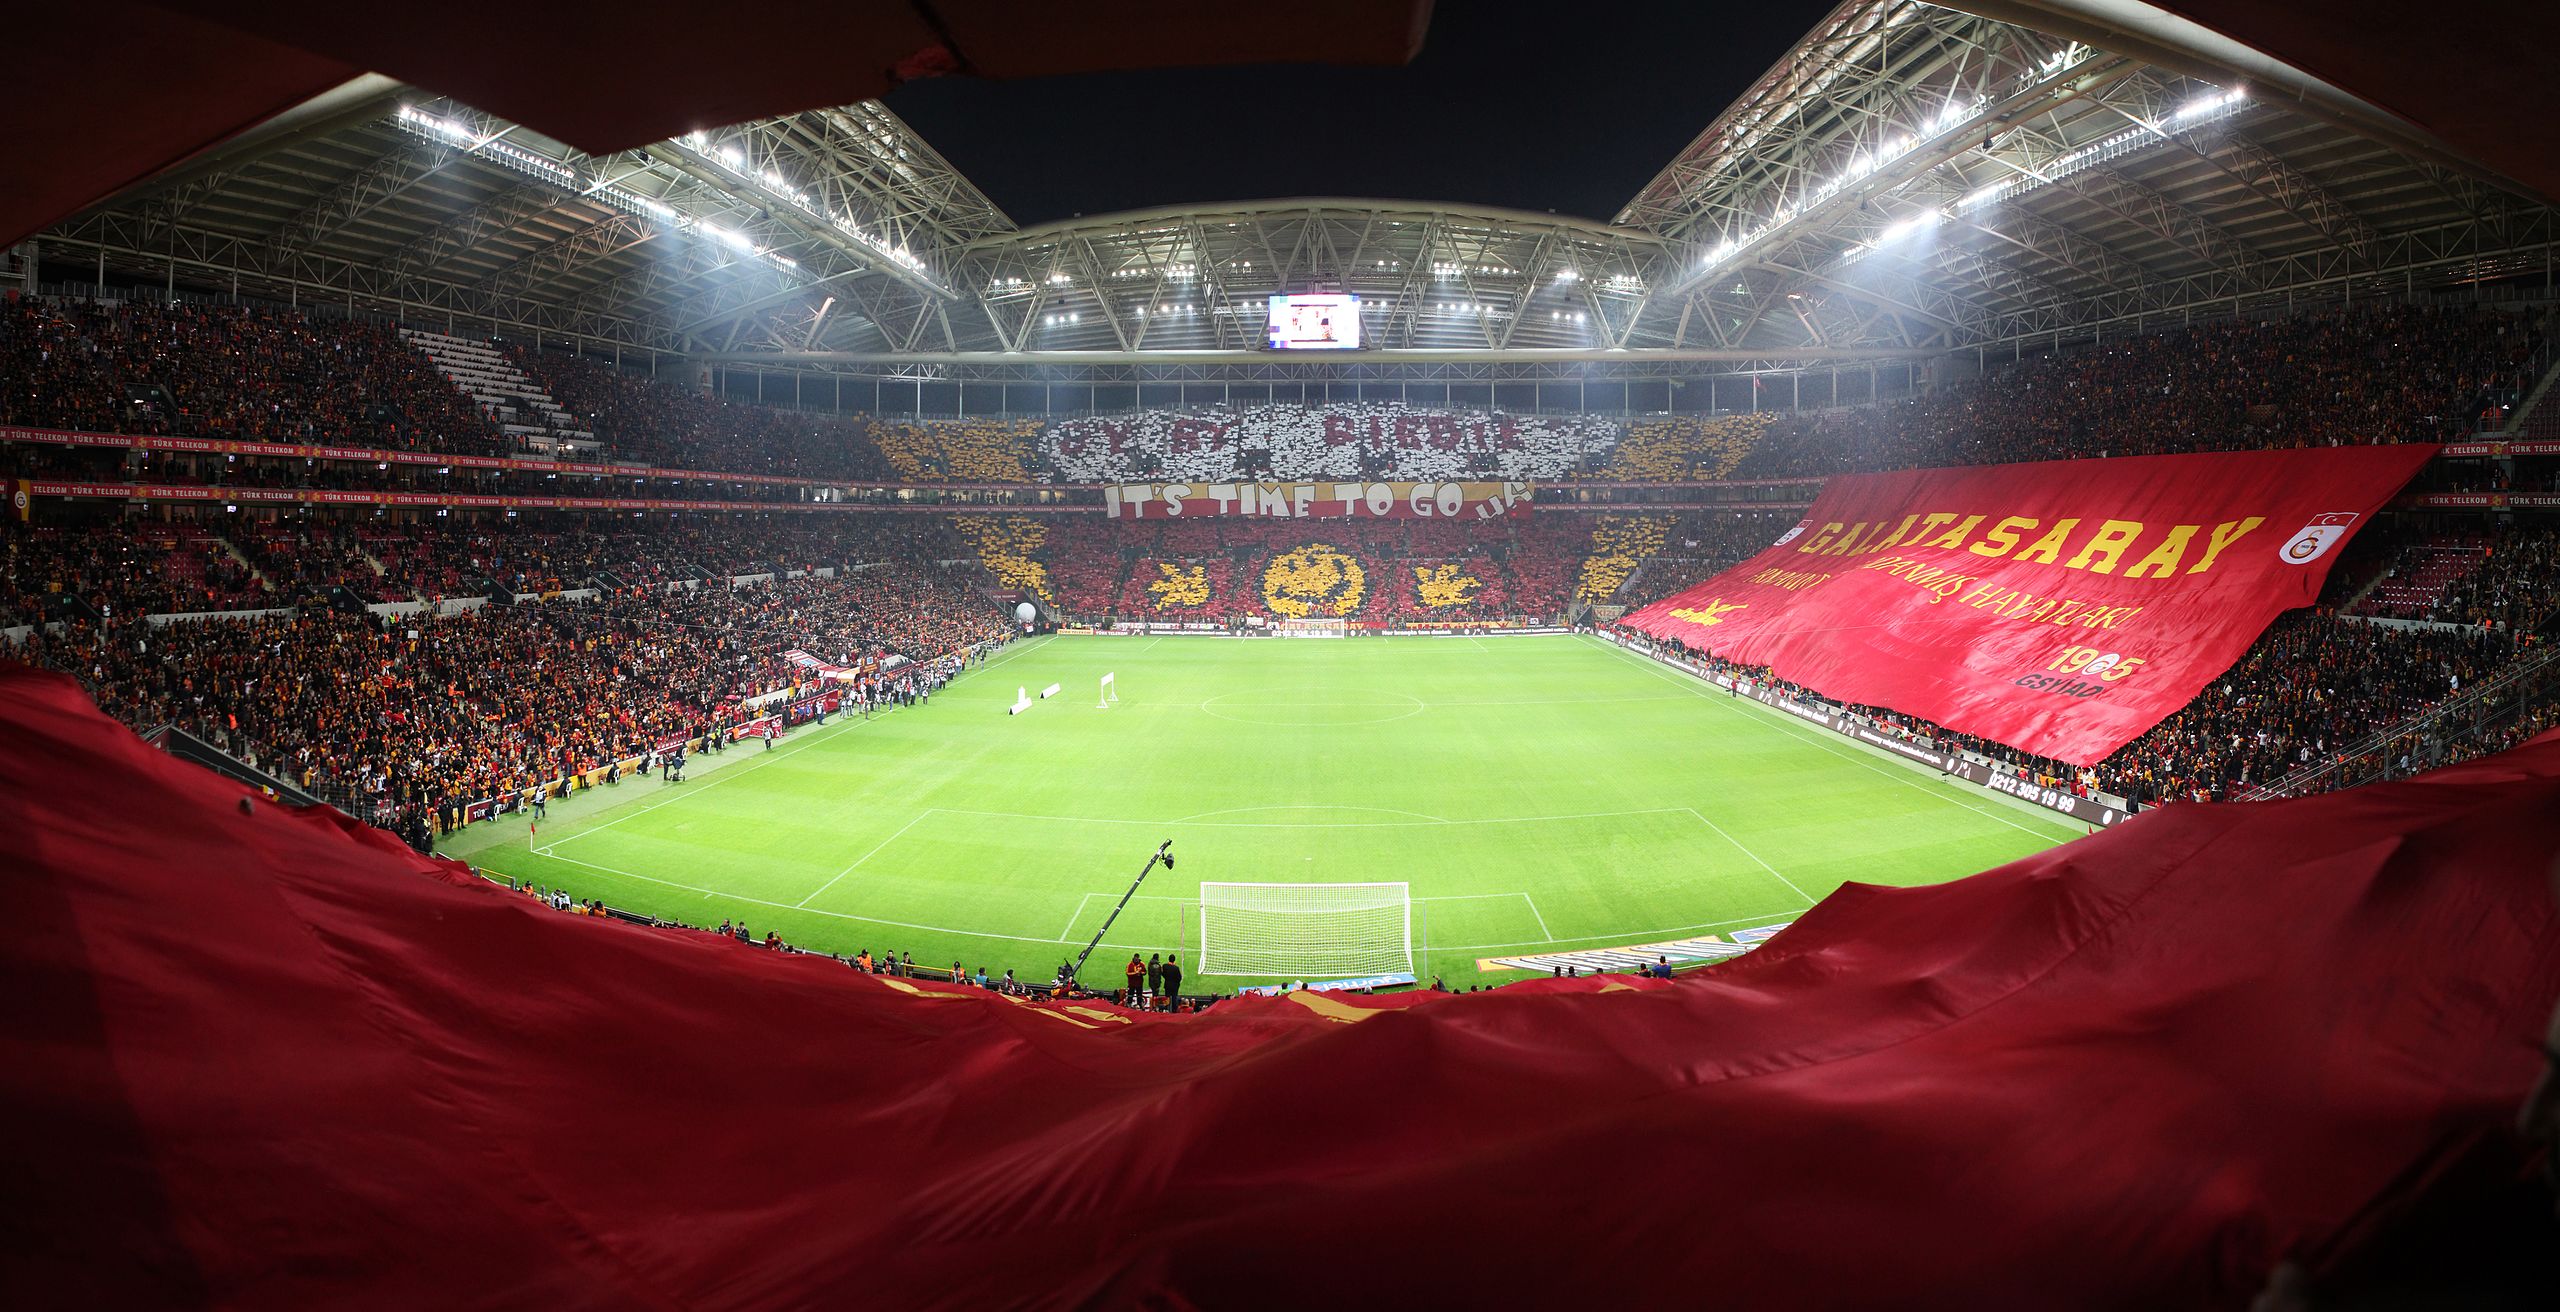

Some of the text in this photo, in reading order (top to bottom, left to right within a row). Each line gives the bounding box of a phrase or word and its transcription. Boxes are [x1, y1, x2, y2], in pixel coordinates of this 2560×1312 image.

[12, 430, 31, 439] TÜRK
[35, 432, 68, 442] TELEKOM
[74, 434, 131, 446] TÜRK TELEKOM
[153, 439, 209, 450] TÜRK TELEKOM
[243, 444, 294, 455] TÜRK TELEKOM
[2511, 445, 2531, 453] TÜRK
[325, 449, 371, 459] TÜRK TELEKOM
[2453, 446, 2488, 454] TELEKOM
[397, 454, 438, 463] TÜRK TELEKOM
[477, 459, 499, 467] TELEKOM
[34, 486, 67, 494] TELEKOM
[72, 486, 130, 496] TÜRK TELEKOM
[152, 488, 208, 498] TÜRK TELEKOM
[242, 491, 293, 500] TÜRK TELEKOM
[324, 493, 371, 502] TÜRK TELEKOM
[414, 496, 438, 504] TELEKOM
[1104, 483, 1193, 519] IT'S
[1207, 483, 1316, 518] TIME
[1333, 482, 1394, 517] TO
[1409, 482, 1464, 517] GO
[2430, 496, 2487, 504] TÜRK TELEKOM
[2510, 496, 2530, 504] TÜRK
[1797, 513, 2266, 579] GALATASARAY
[1958, 583, 2144, 629] HAYATLAR!
[1989, 773, 2076, 812] 0212 305 19 99
[473, 809, 488, 819] TÜR
